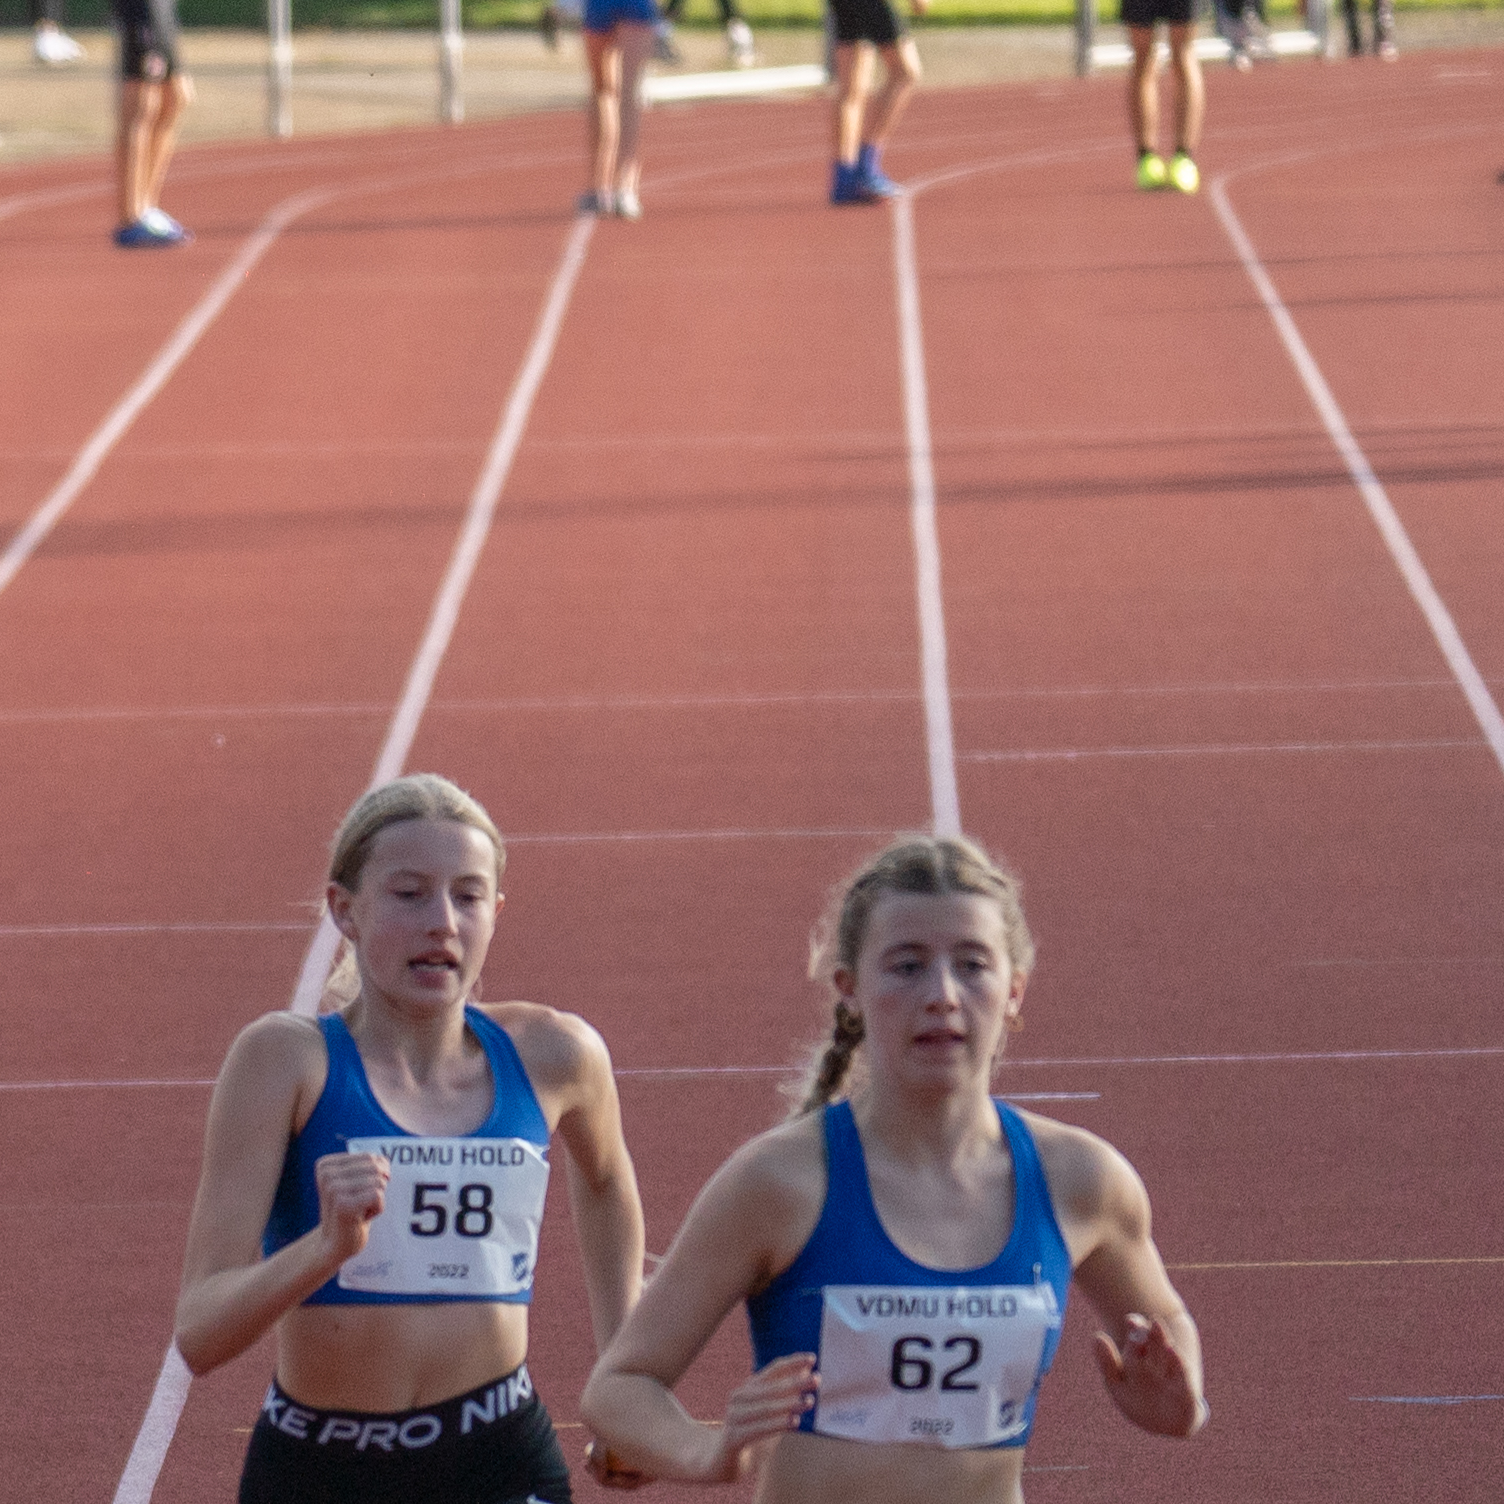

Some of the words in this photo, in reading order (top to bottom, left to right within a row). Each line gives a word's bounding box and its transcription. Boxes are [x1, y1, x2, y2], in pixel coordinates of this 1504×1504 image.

[380, 1145, 454, 1166] VDMU
[461, 1145, 525, 1167] HOLD
[410, 1182, 494, 1238] 58
[856, 1294, 940, 1318] VDMU
[947, 1294, 1018, 1318] HOLD
[890, 1335, 983, 1391] 62
[316, 1413, 443, 1451] PRO
